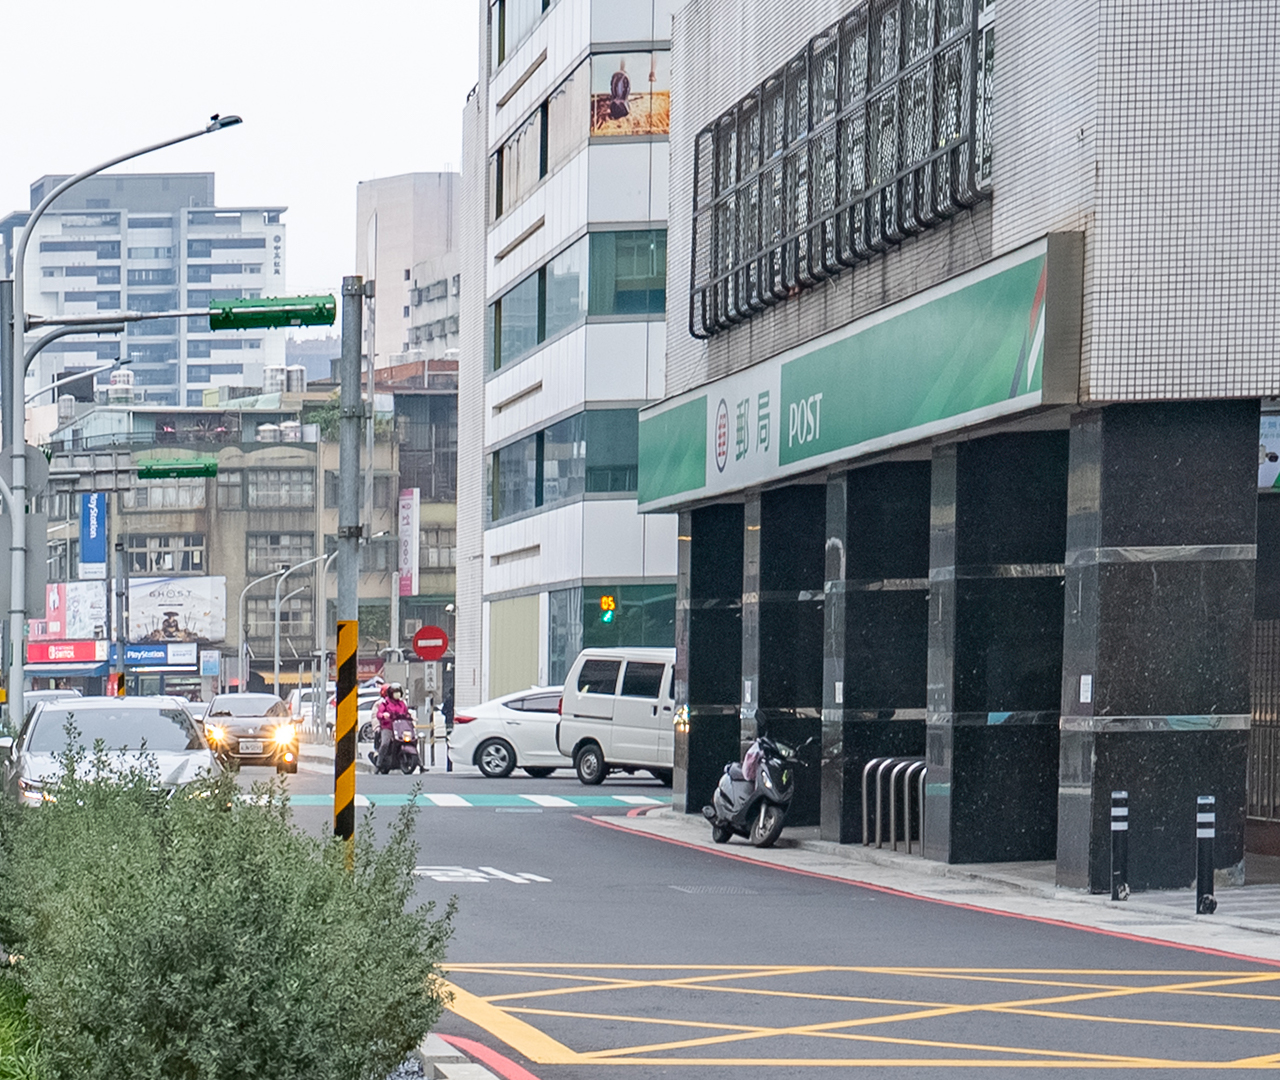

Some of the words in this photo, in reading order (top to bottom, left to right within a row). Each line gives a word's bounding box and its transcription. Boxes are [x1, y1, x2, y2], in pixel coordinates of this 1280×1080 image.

[735, 390, 771, 462] 郵局
[788, 392, 823, 448] POST
[87, 493, 99, 540] layStation
[149, 590, 192, 598] GHOST
[127, 650, 165, 660] PlayStation
